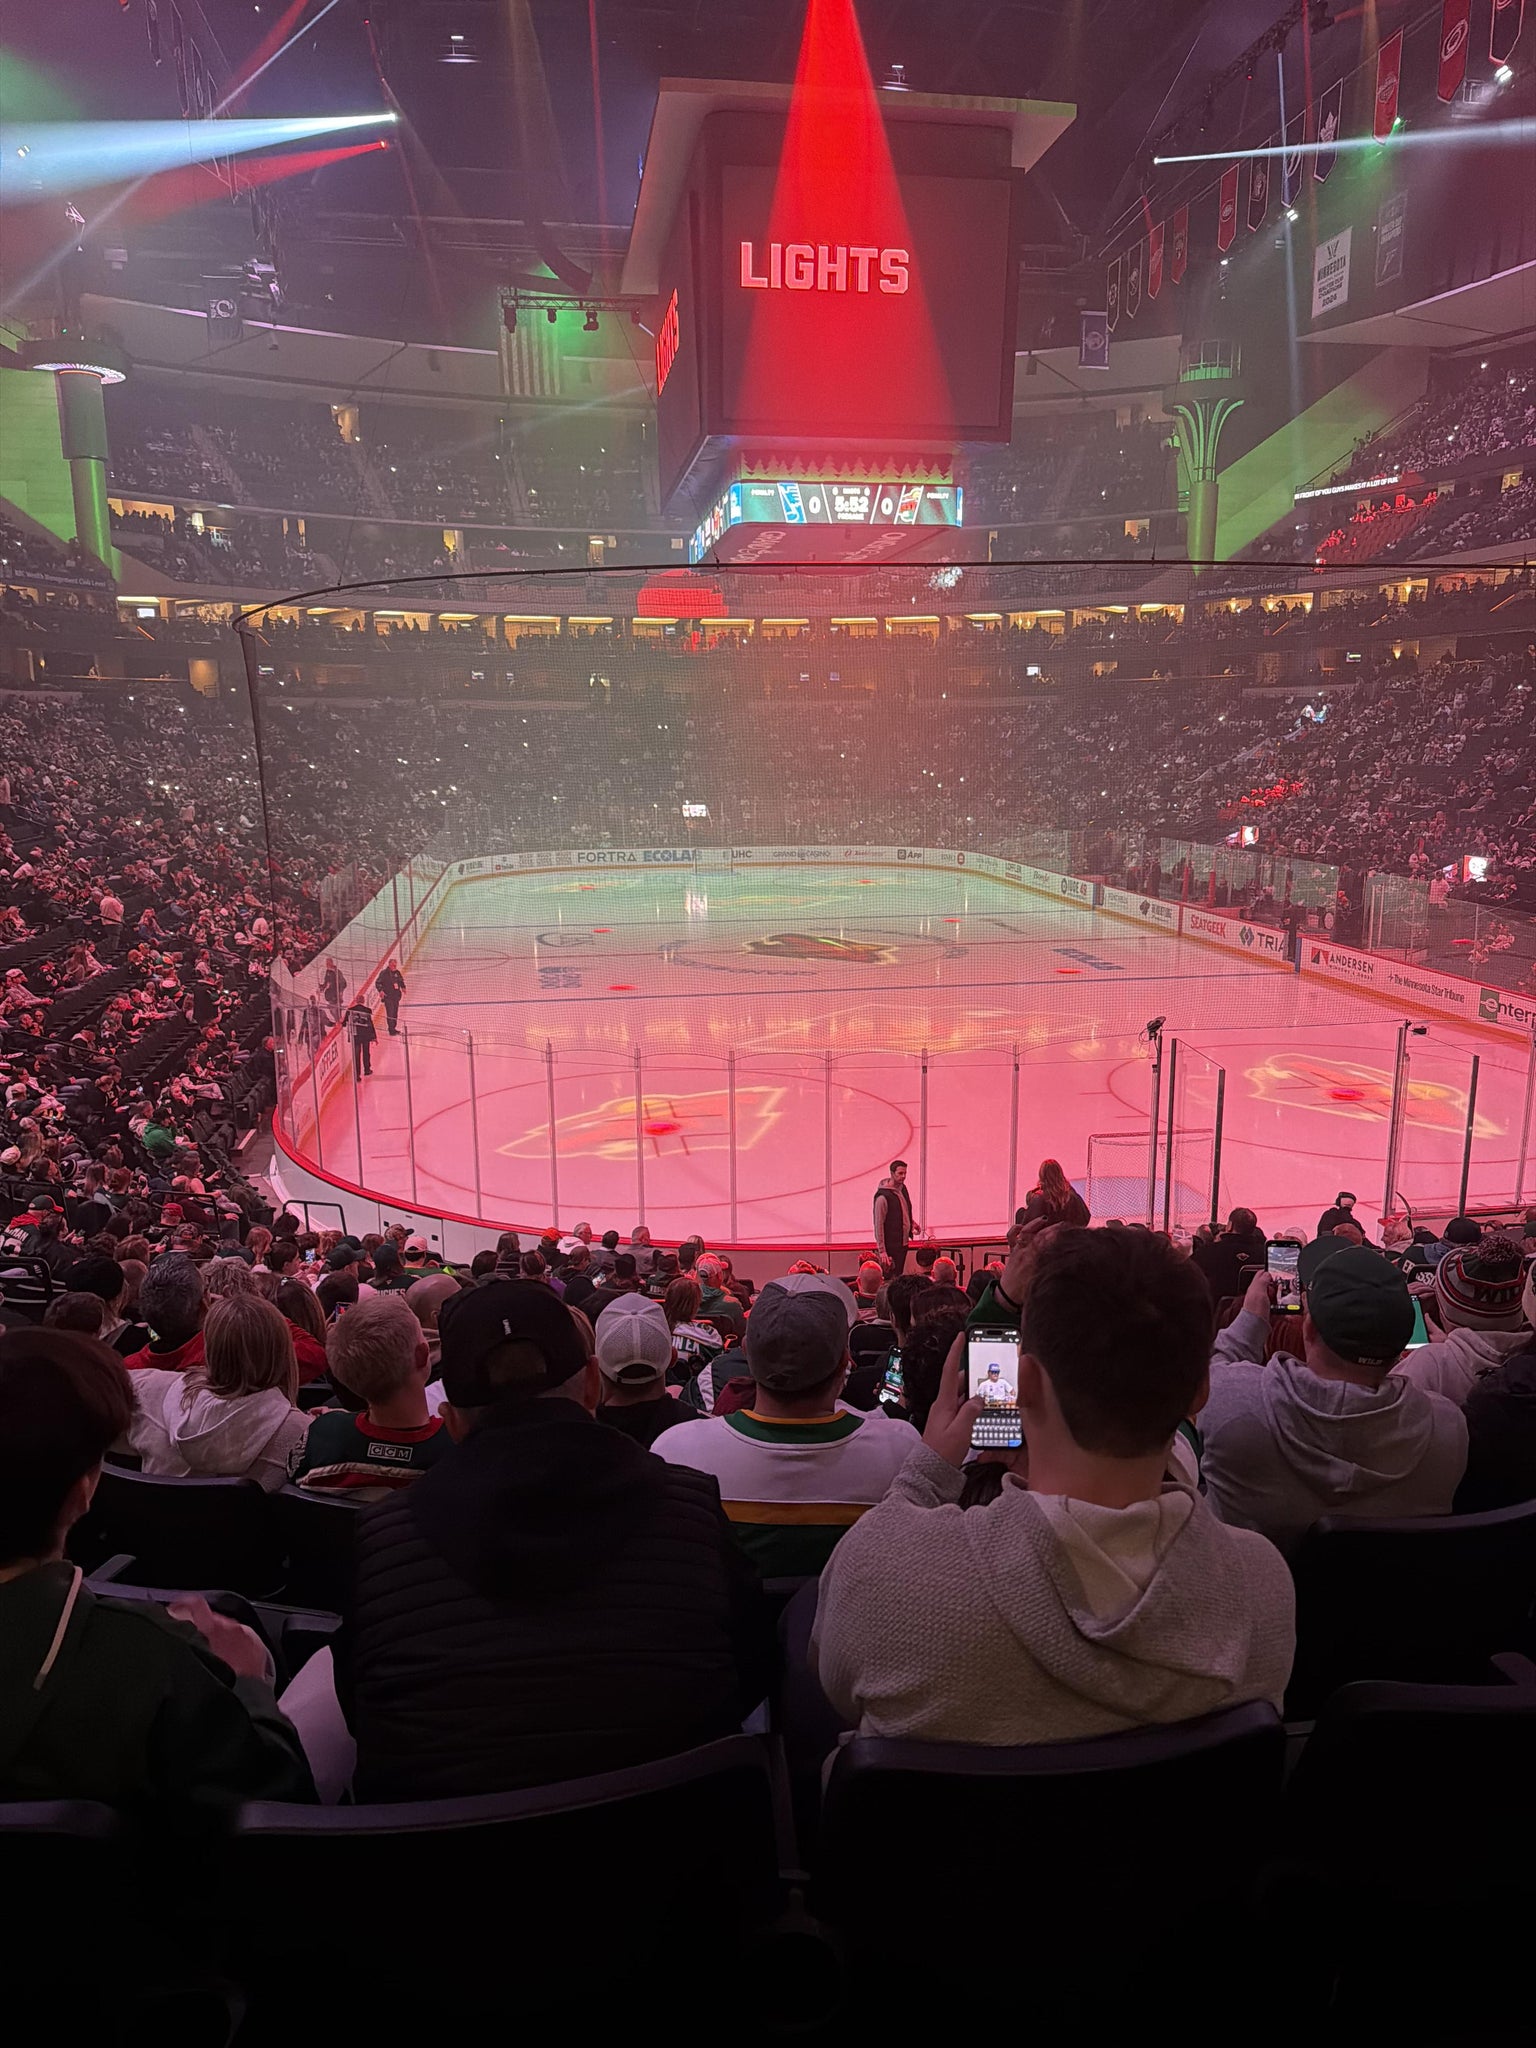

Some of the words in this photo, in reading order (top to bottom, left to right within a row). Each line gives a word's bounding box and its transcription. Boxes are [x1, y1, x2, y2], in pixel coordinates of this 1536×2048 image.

[741, 241, 909, 294] LIGHTS
[808, 496, 821, 514] 0
[834, 495, 869, 513] 5:52
[880, 497, 893, 515] 0
[577, 851, 637, 863] FORTRA
[732, 850, 752, 859] UHC
[1190, 914, 1227, 939] SEATGEEK
[1329, 953, 1374, 974] ANDERSEN
[1394, 974, 1403, 986] The
[1403, 976, 1431, 994] Minnesota
[1431, 983, 1444, 998] Star
[1443, 987, 1465, 1004] Tribune
[370, 1444, 411, 1459] CCM
